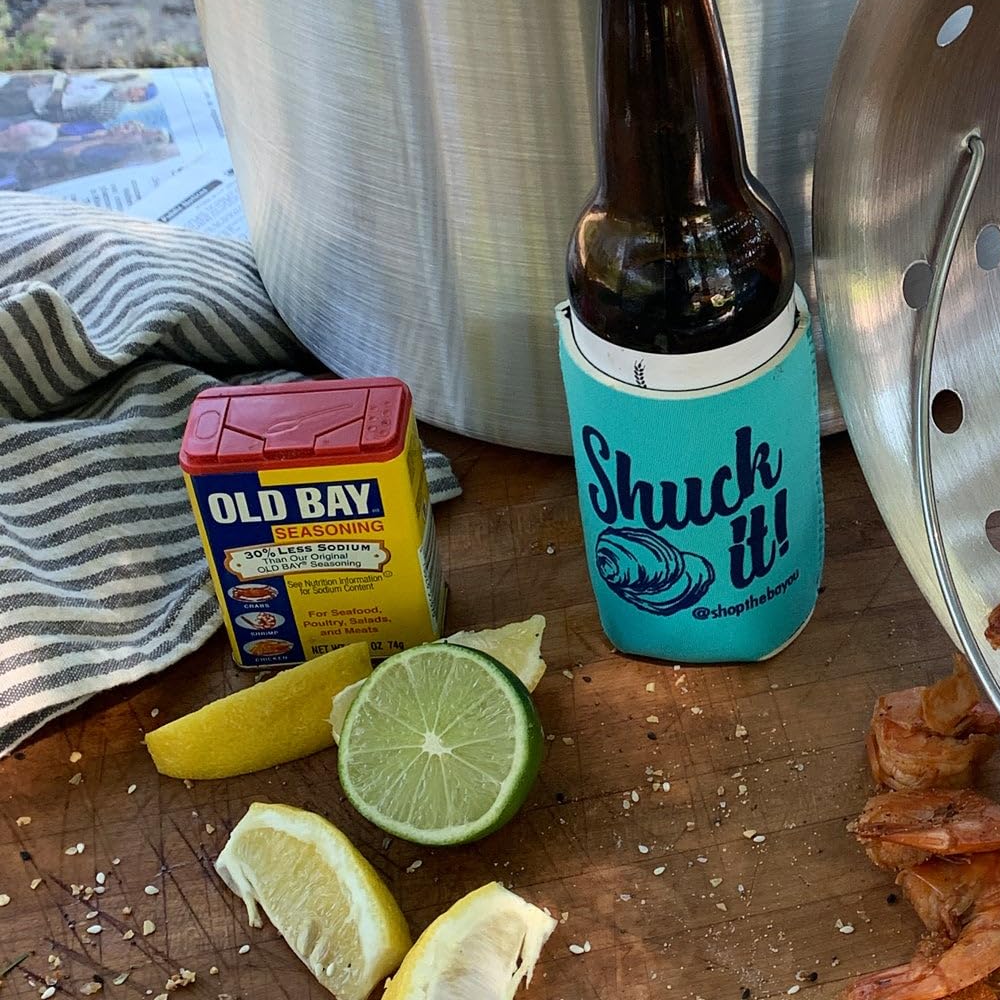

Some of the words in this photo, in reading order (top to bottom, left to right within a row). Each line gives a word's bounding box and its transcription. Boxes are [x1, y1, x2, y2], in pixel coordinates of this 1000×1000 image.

[582, 425, 782, 531] Shuck
[208, 489, 287, 524] OLD
[295, 482, 371, 519] BAY
[275, 520, 385, 540] SEASONING
[729, 488, 789, 589] it!
[244, 547, 276, 560] 30%
[262, 555, 288, 565] Than
[289, 553, 308, 562] Our
[310, 552, 348, 561] Original
[257, 565, 279, 574] OLD
[310, 560, 362, 569] Seasoning
[287, 579, 303, 589] See
[304, 577, 338, 587] Nutrition
[339, 574, 383, 584] Information
[299, 586, 311, 595] for
[312, 585, 343, 594] Sodium
[344, 582, 375, 592] Content
[308, 610, 328, 618] For
[331, 606, 383, 616] Seafood,
[303, 618, 347, 629] Poultry,
[350, 615, 393, 625] Salads,
[345, 626, 379, 635] Meats
[311, 644, 329, 655] NET
[370, 641, 384, 651] OZ
